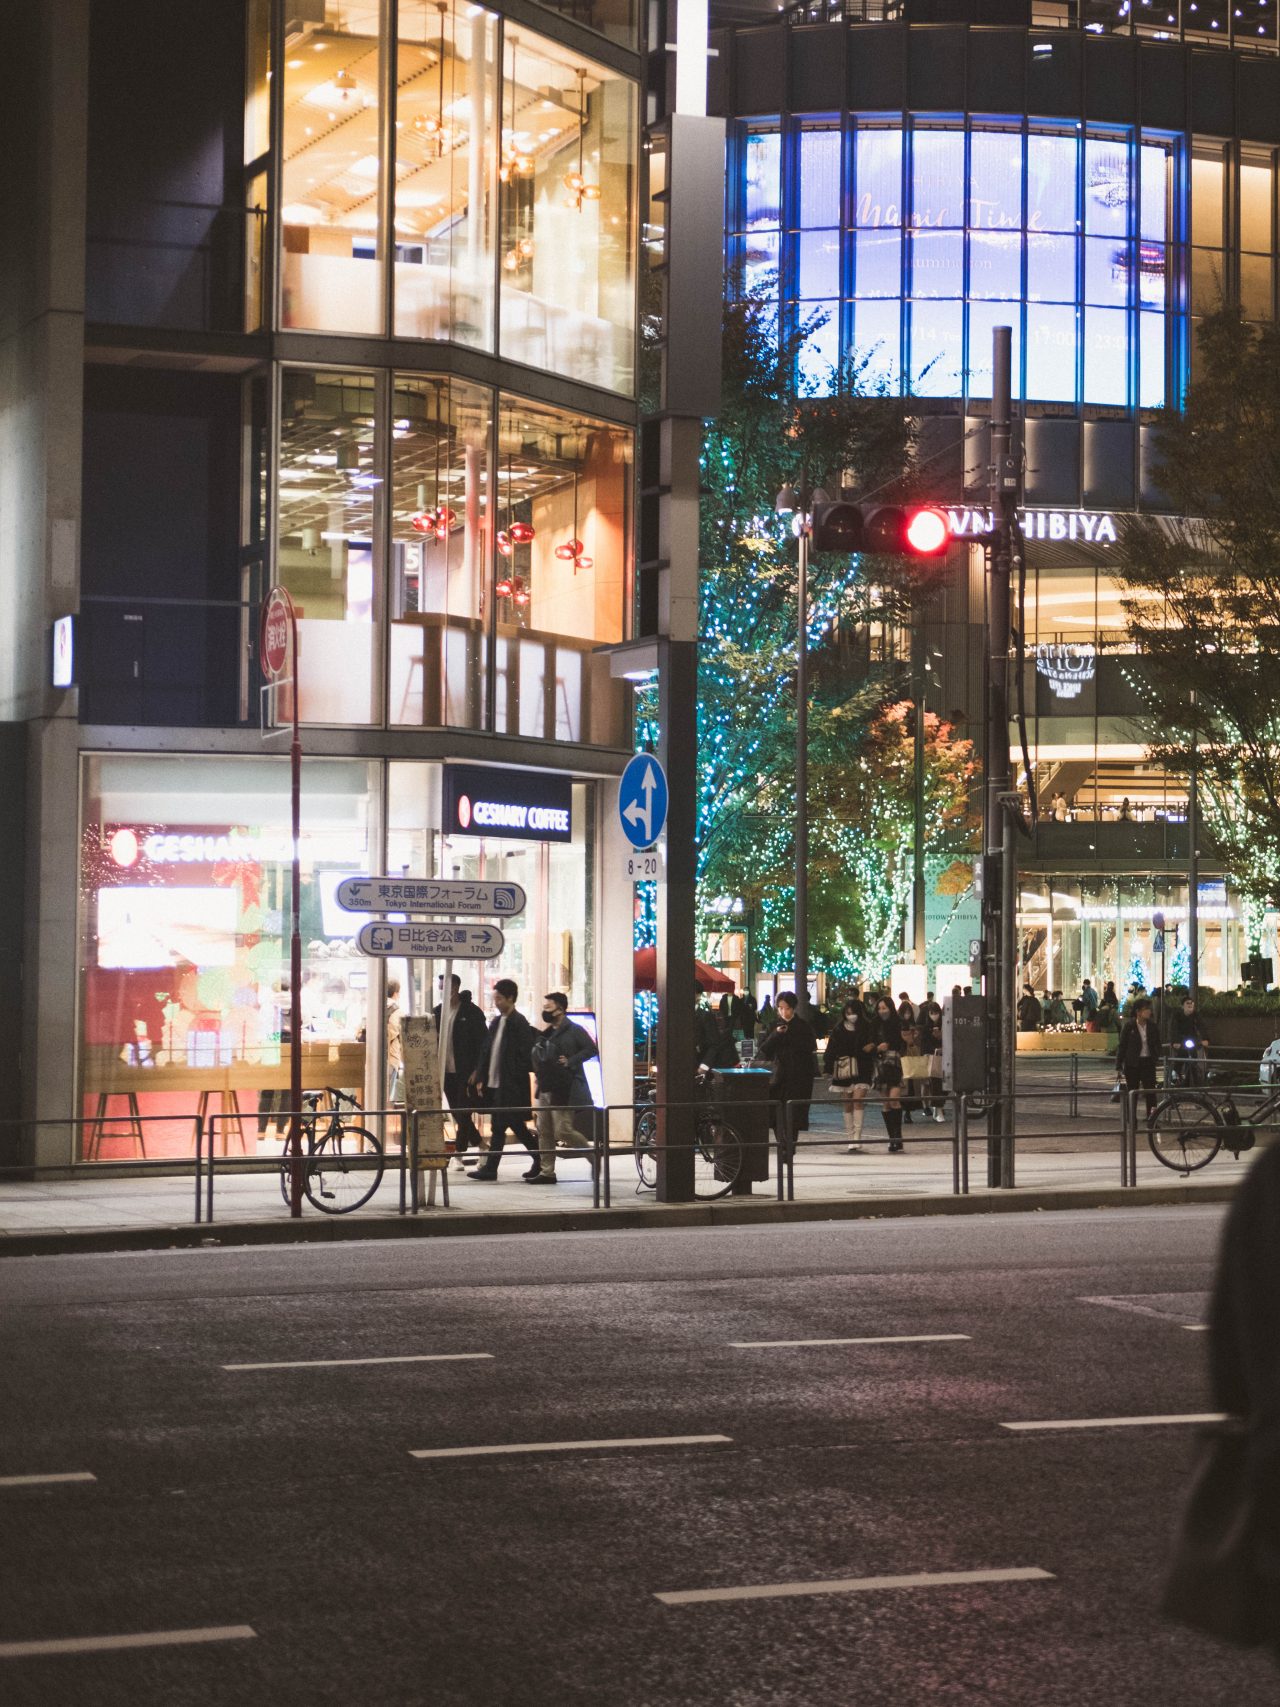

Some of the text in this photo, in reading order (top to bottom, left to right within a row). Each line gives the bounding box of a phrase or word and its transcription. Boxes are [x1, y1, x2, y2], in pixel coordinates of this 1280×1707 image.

[473, 801, 569, 831] GESHARY COFFEE
[378, 884, 488, 901] 東京国際フォーラム
[349, 897, 481, 910] 350m Tokyo International Forum
[398, 928, 467, 943] 日比谷公園
[411, 943, 493, 954] Hibiya Park 170m
